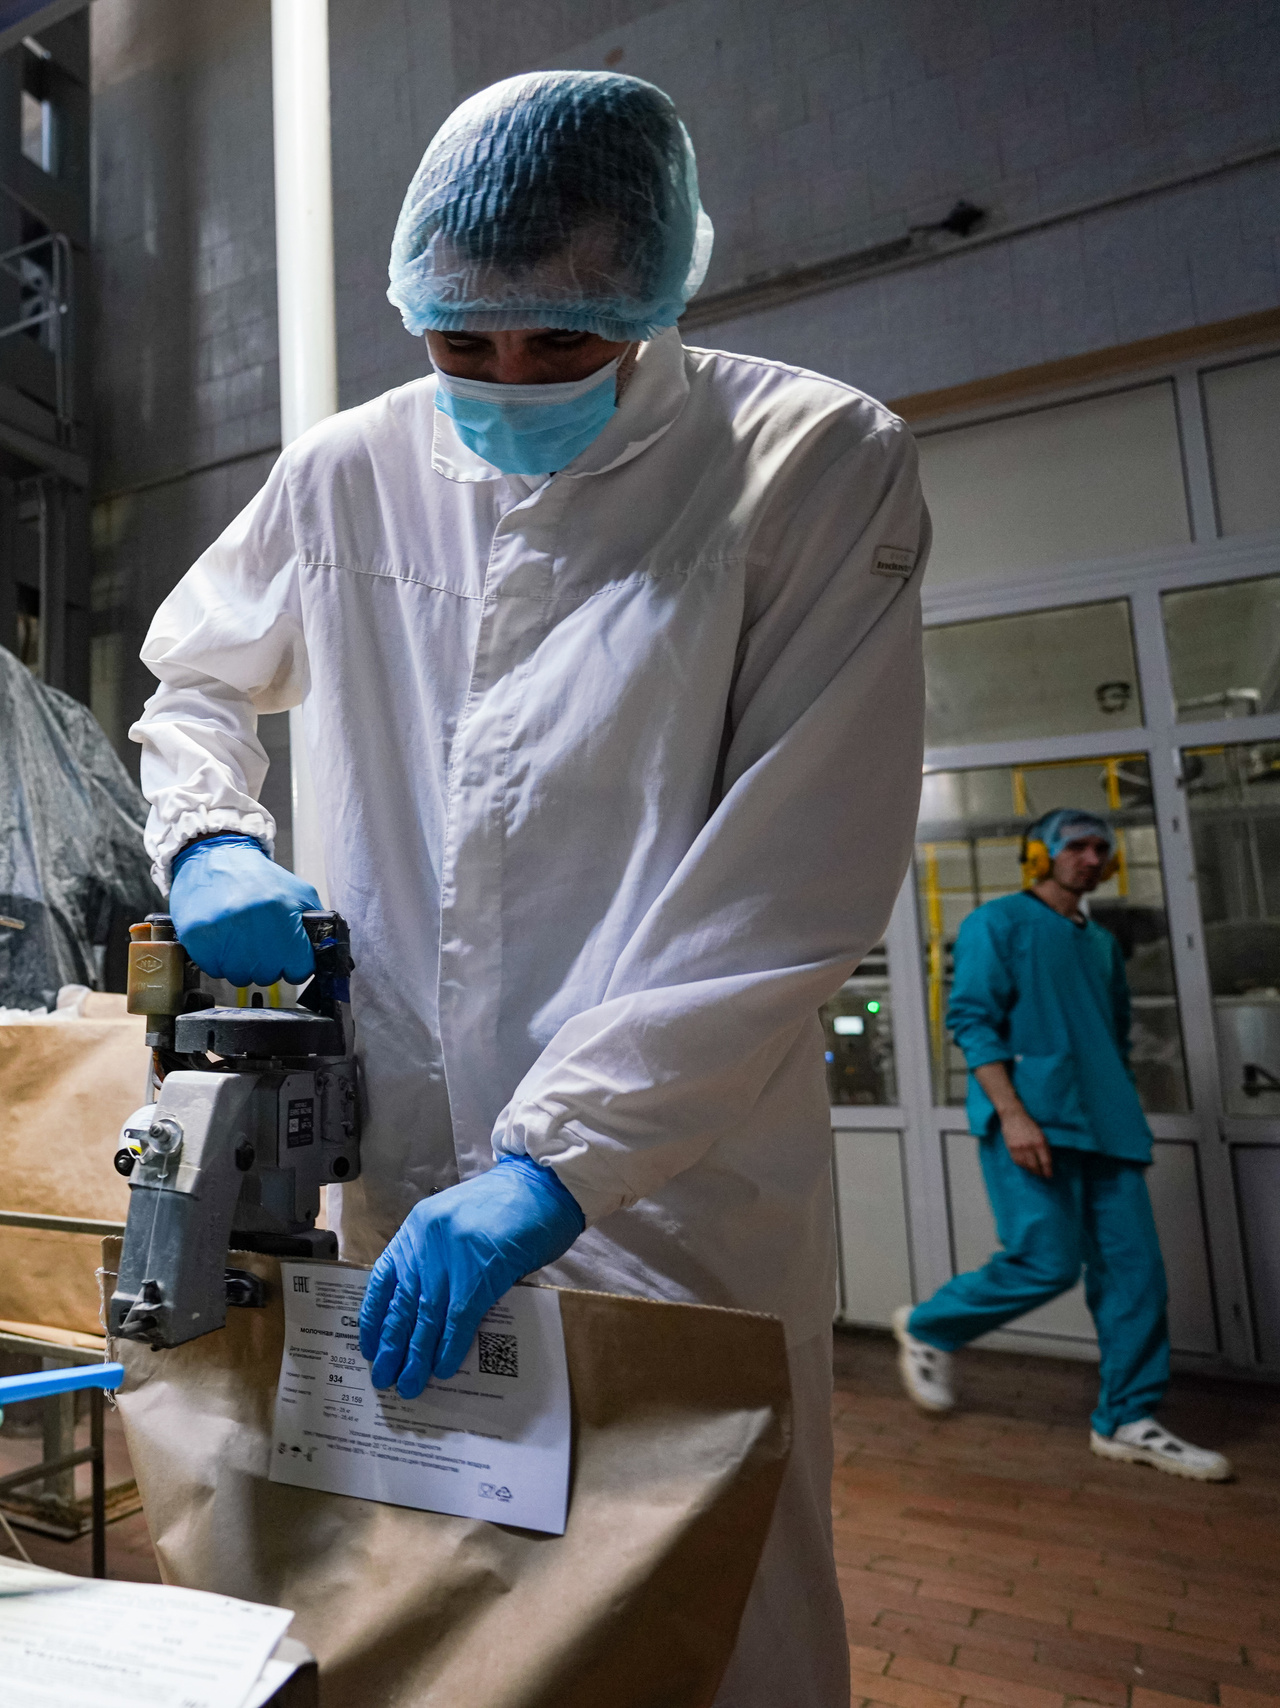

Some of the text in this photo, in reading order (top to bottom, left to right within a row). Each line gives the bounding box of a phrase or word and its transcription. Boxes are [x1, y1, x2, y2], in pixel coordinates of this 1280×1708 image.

[346, 1343, 361, 1352] ГОС
[330, 1355, 356, 1365] 30.03.23
[328, 1374, 343, 1383] 934
